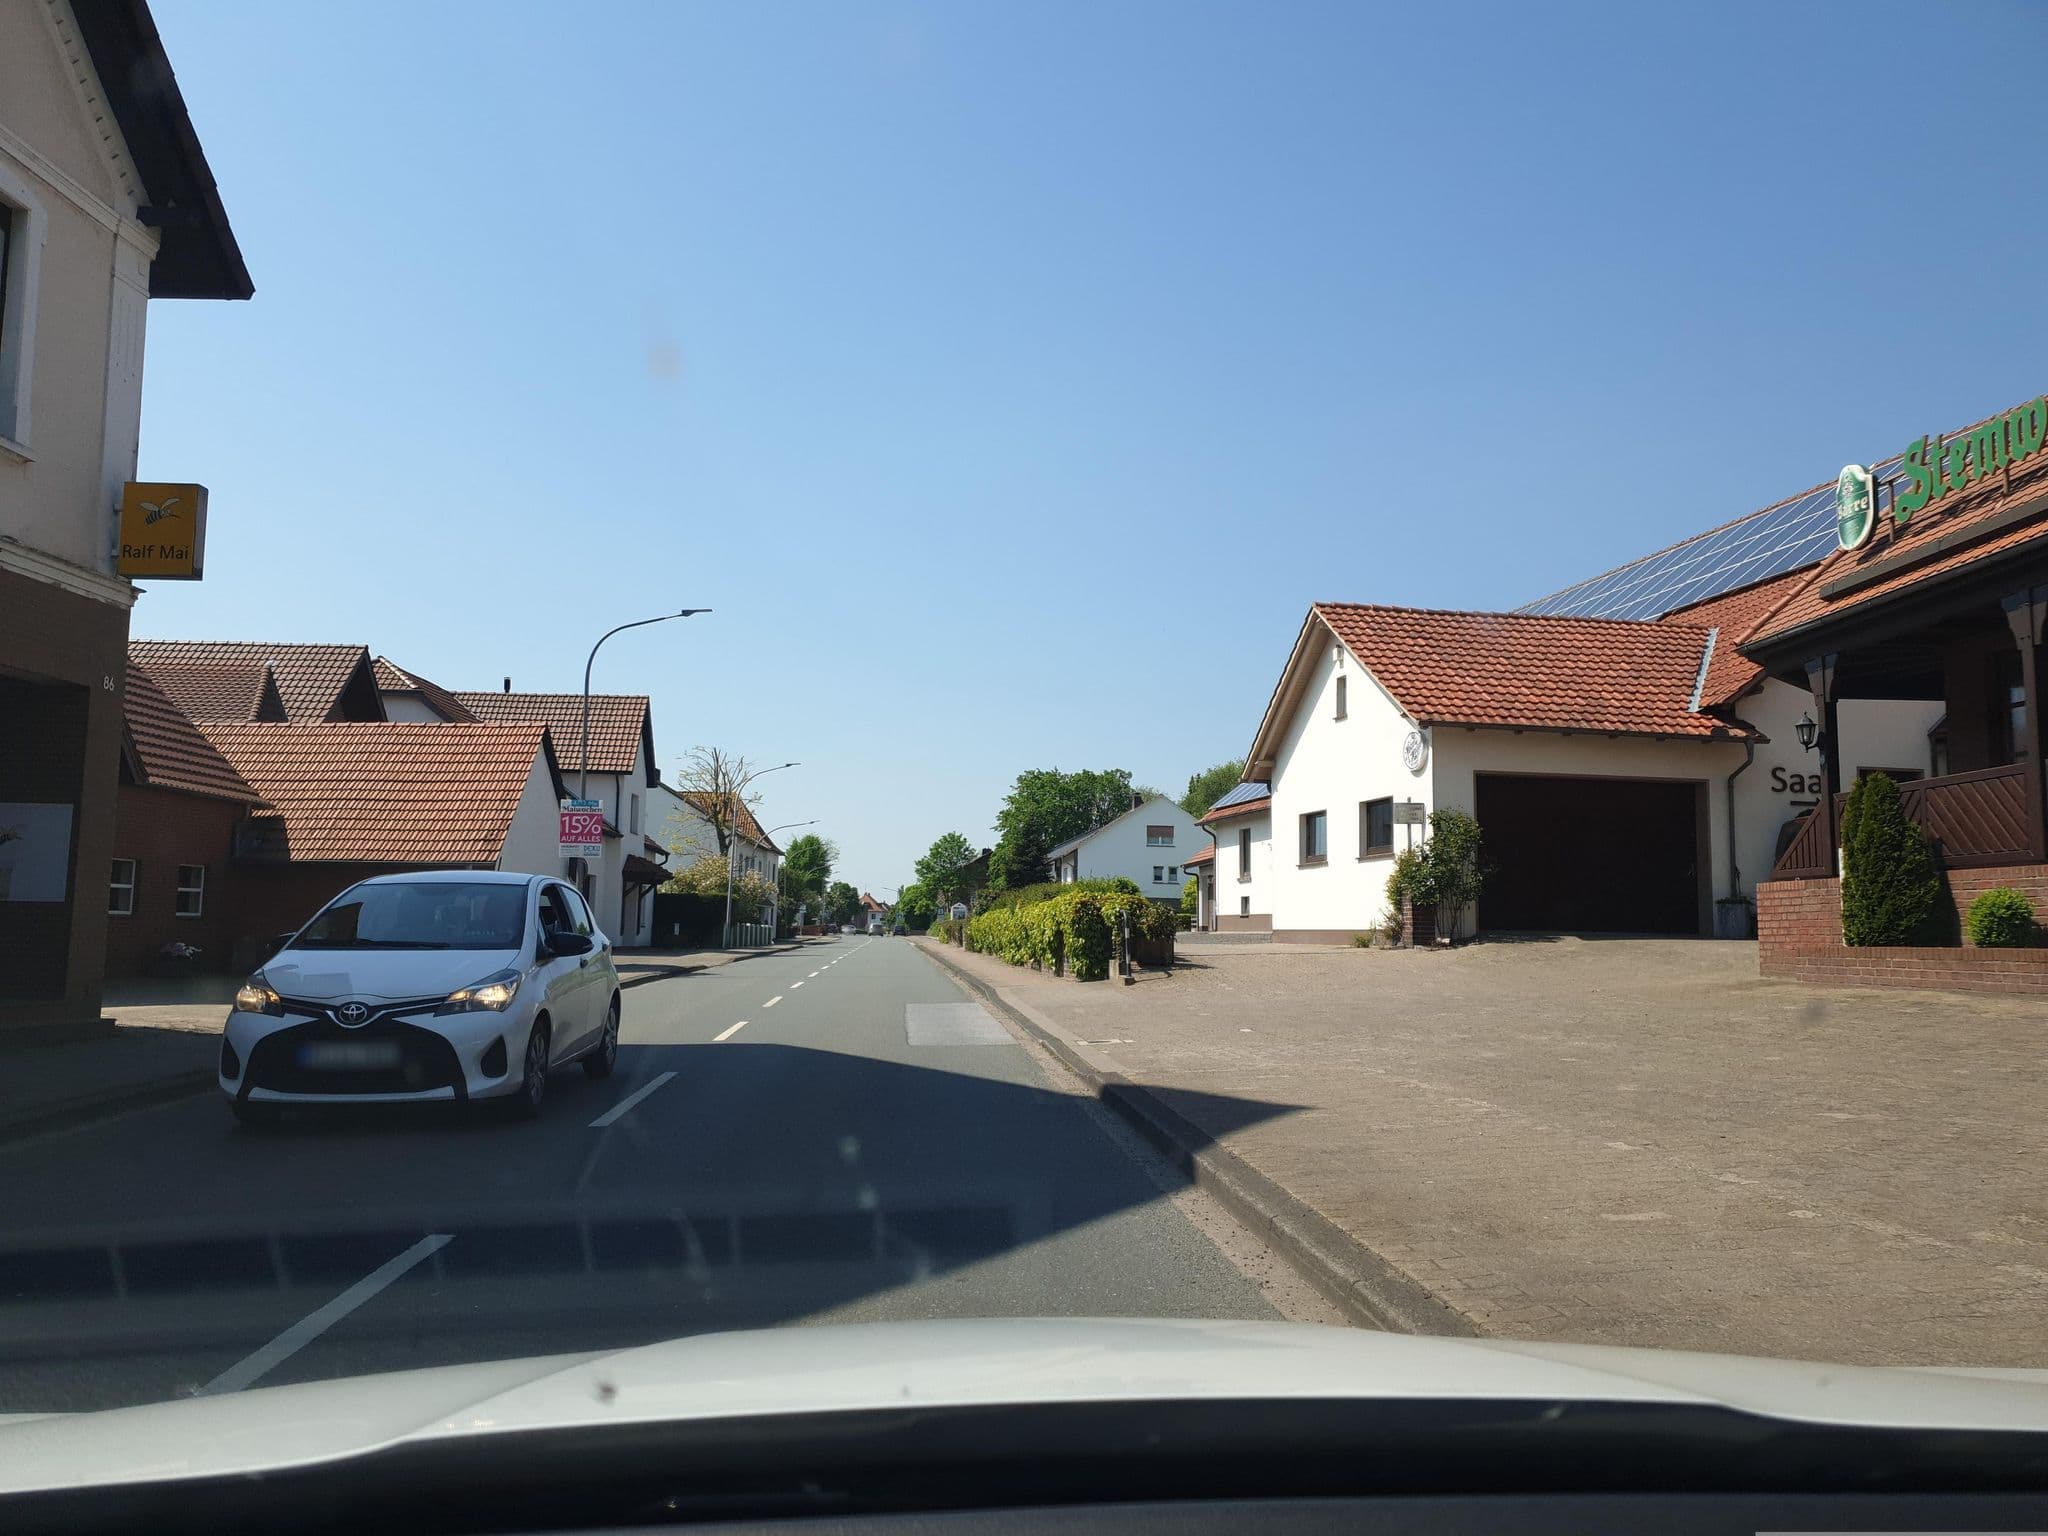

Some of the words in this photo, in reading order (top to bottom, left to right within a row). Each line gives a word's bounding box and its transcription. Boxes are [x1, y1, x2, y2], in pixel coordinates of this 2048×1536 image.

[122, 544, 156, 559] Ralf
[160, 545, 189, 560] Mai
[103, 676, 115, 691] 86
[561, 815, 602, 834] 15%
[577, 835, 601, 843] ALLES
